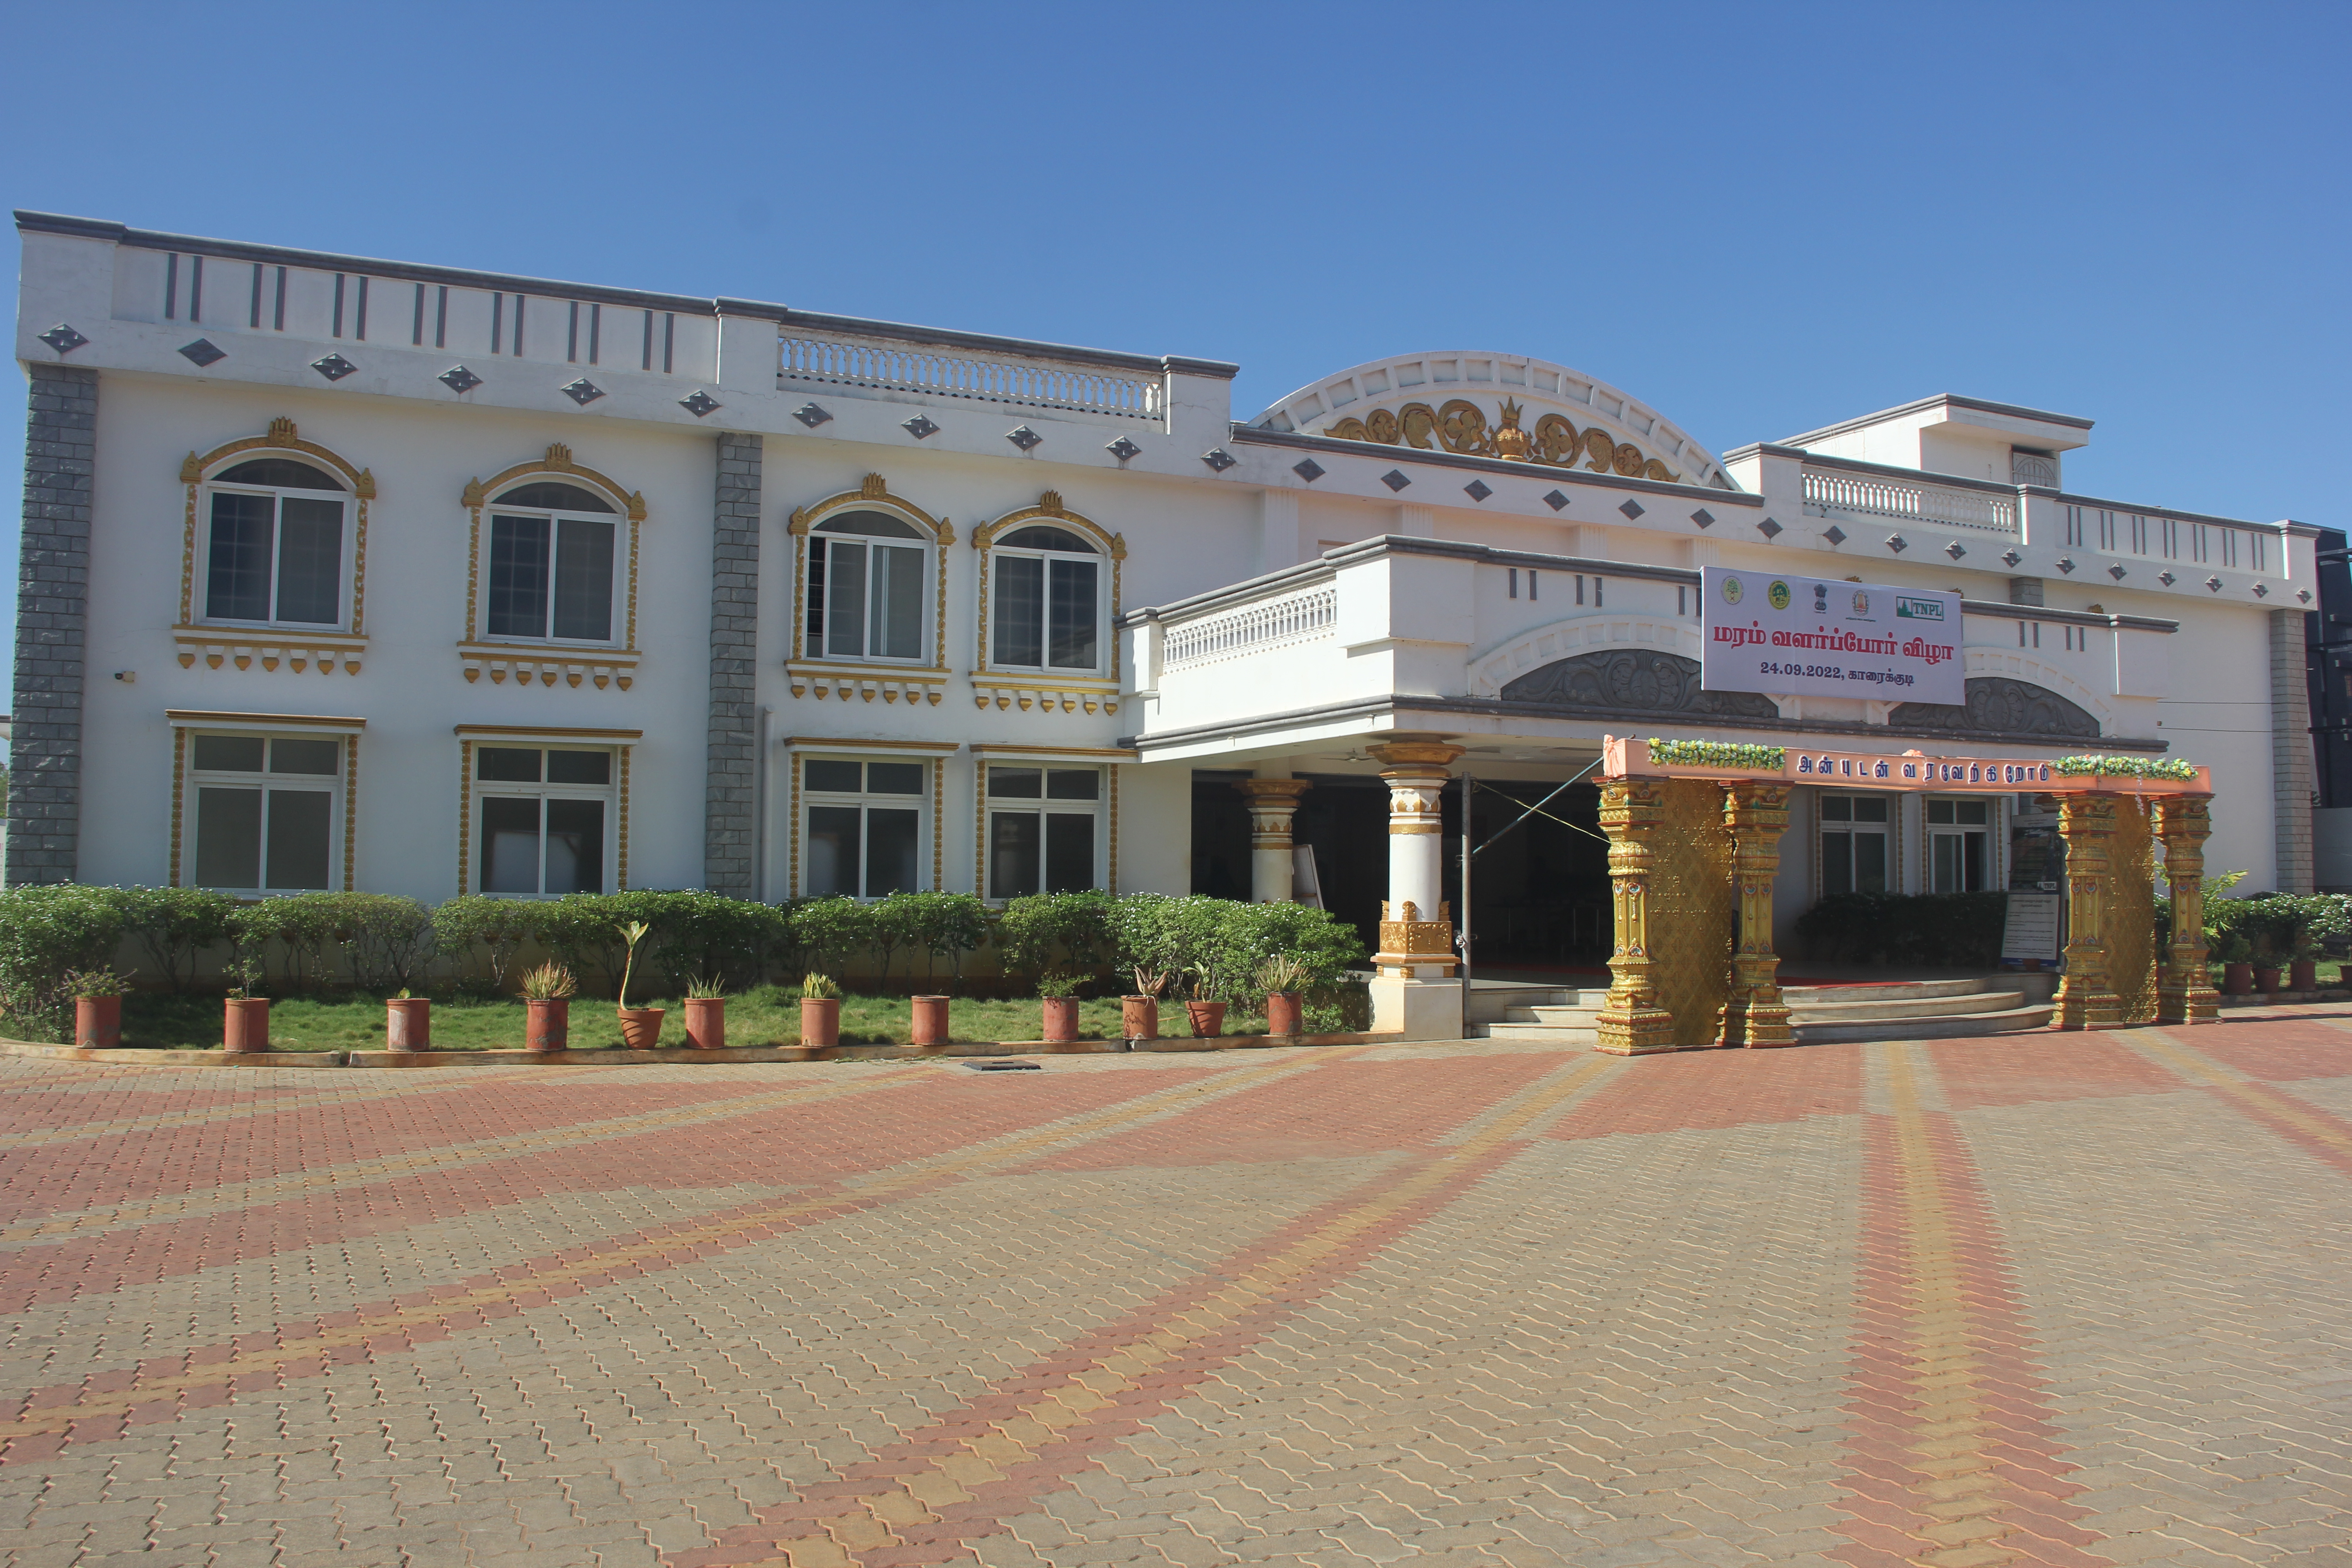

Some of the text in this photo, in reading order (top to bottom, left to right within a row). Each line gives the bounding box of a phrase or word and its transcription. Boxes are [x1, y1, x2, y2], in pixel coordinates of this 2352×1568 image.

[1913, 602, 1942, 617] TNPL
[1714, 620, 1954, 665] மரம் வளர்ப்போர் விழா
[1760, 661, 1915, 687] 24.09.2022, காரைக்குடி
[1797, 755, 2049, 784] அன்புடன் வரவேற்கிறோம்
